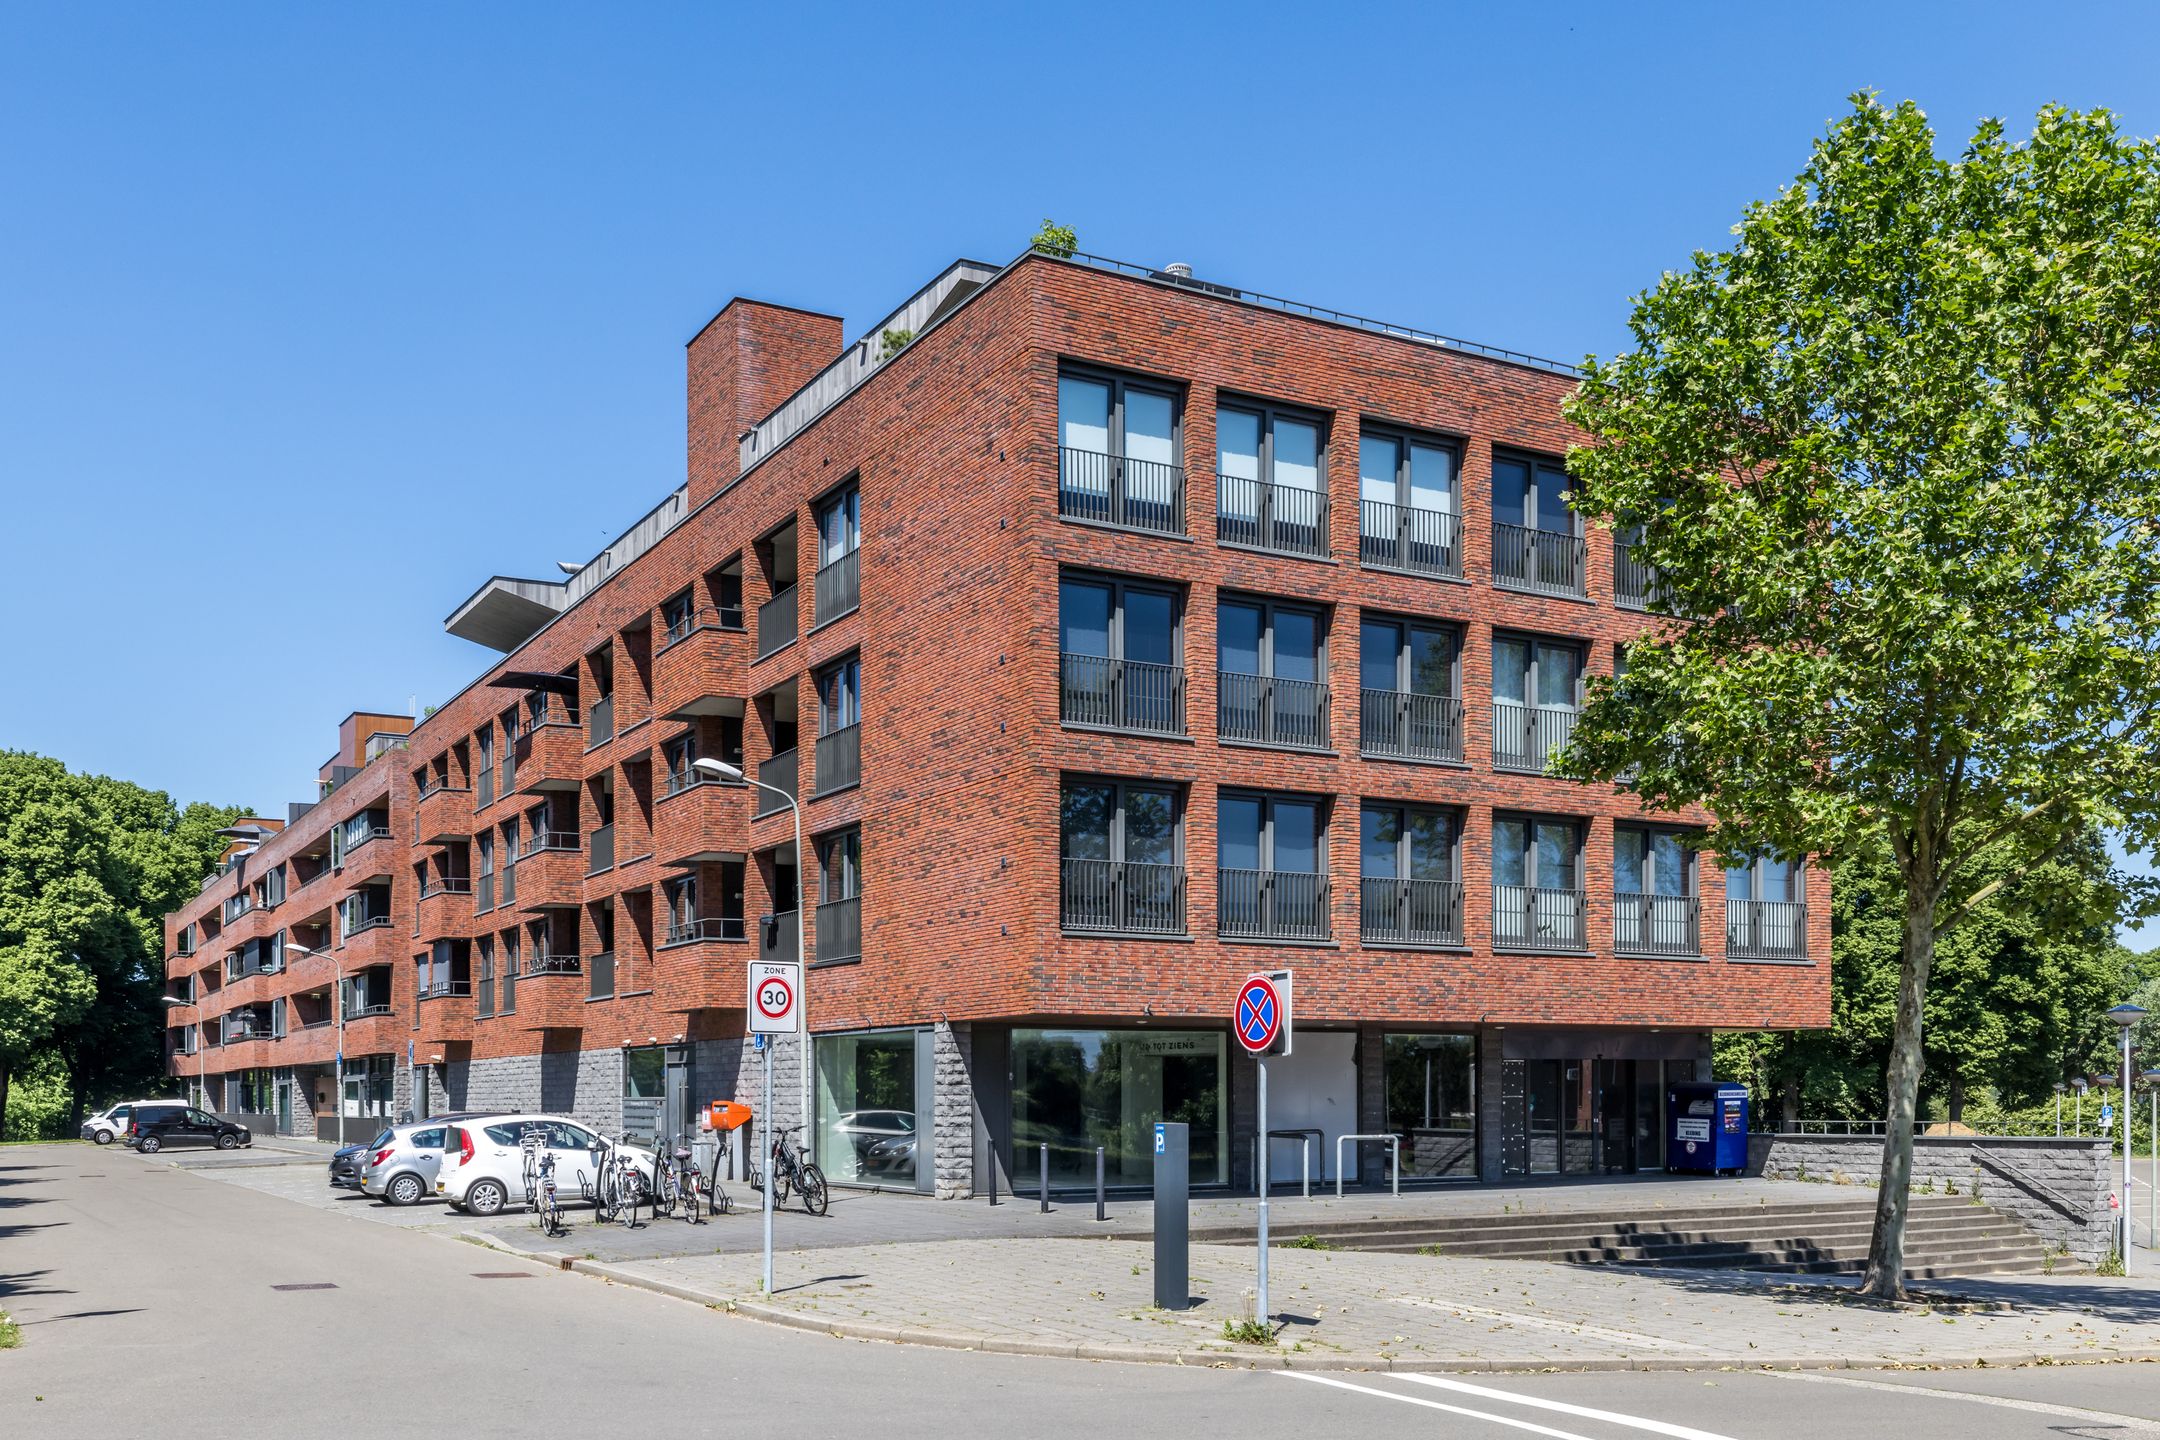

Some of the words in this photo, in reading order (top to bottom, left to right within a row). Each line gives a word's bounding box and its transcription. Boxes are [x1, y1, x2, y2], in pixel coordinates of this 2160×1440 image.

[764, 967, 786, 975] ZONE
[763, 990, 787, 1006] 30
[1153, 1042, 1166, 1051] TOT
[1169, 1041, 1195, 1050] ZIENS
